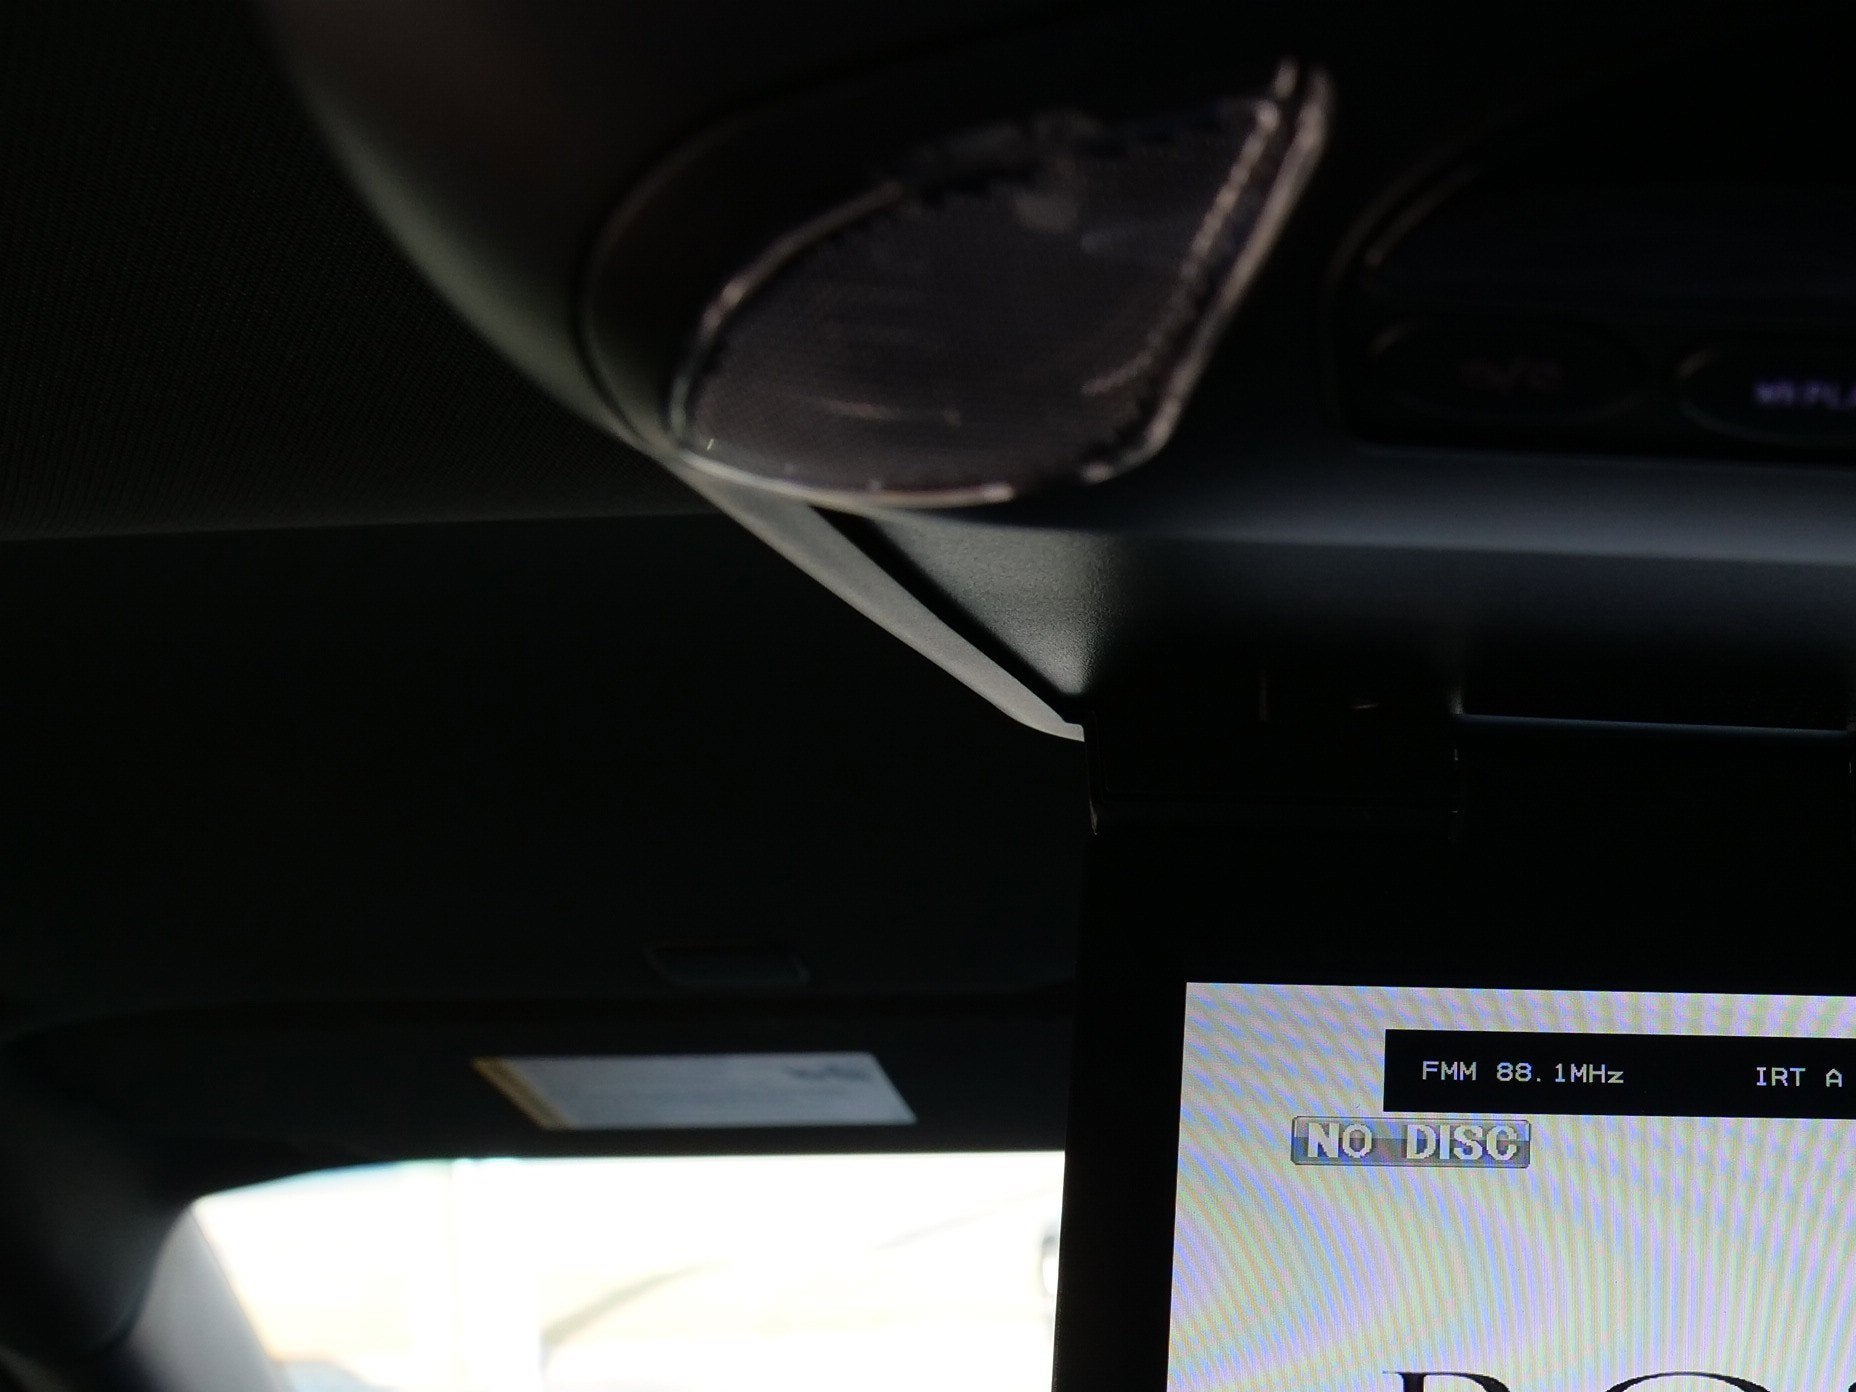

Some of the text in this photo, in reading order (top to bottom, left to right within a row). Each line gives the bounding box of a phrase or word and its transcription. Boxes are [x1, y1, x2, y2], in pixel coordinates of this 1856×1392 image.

[1421, 1060, 1625, 1084] FMM 88.1MHz
[1755, 1066, 1806, 1087] IRT
[1825, 1068, 1844, 1088] A
[1306, 1121, 1519, 1161] NO DISC
